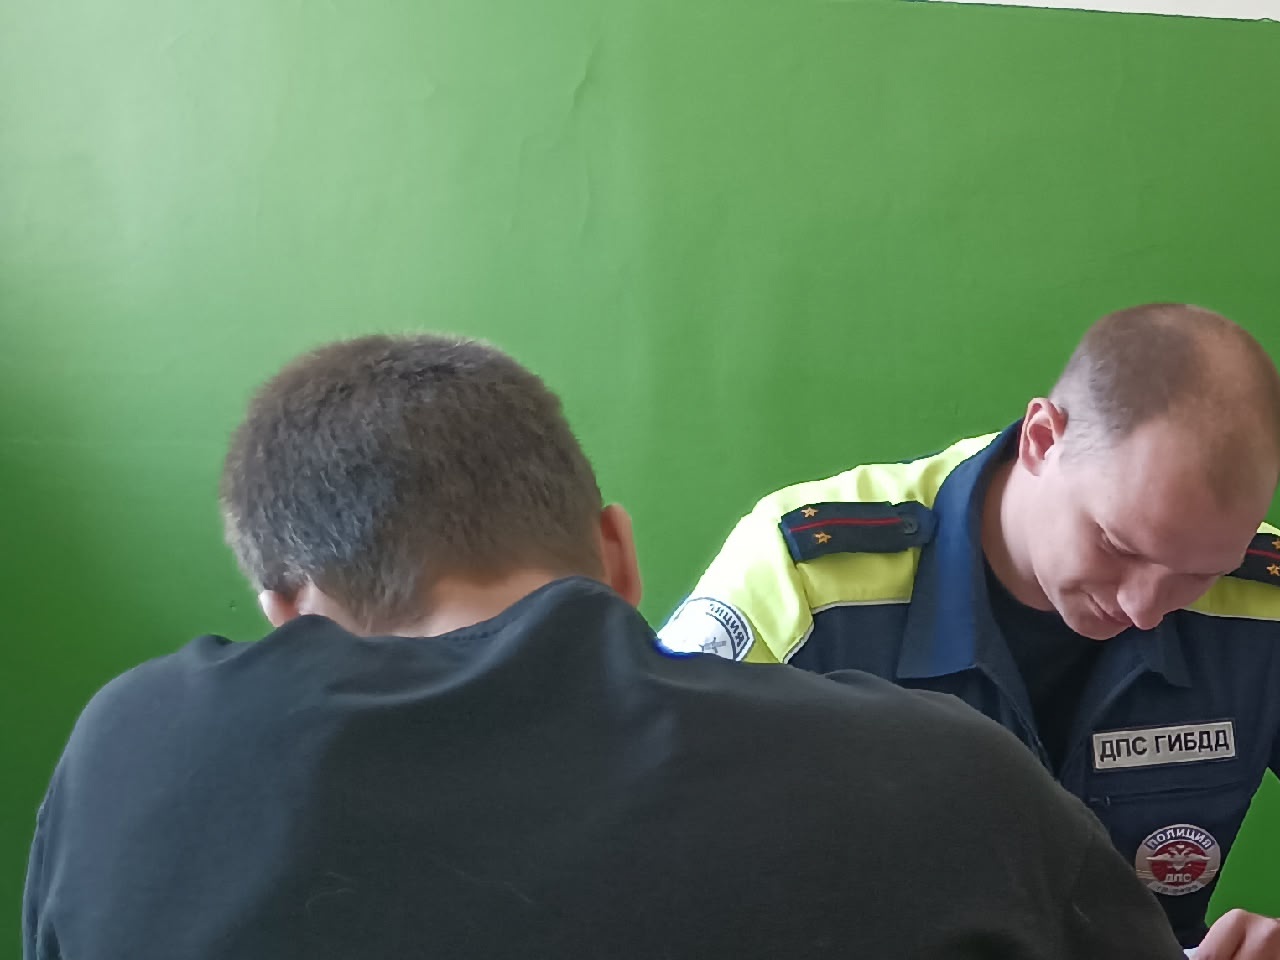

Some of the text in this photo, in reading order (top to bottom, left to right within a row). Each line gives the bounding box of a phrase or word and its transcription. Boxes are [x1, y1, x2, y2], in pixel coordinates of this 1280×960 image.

[1100, 729, 1229, 762] ДПС ГИБДД
[1146, 828, 1212, 849] ПОЛИЦИЯ
[1164, 873, 1192, 883] ДПС
